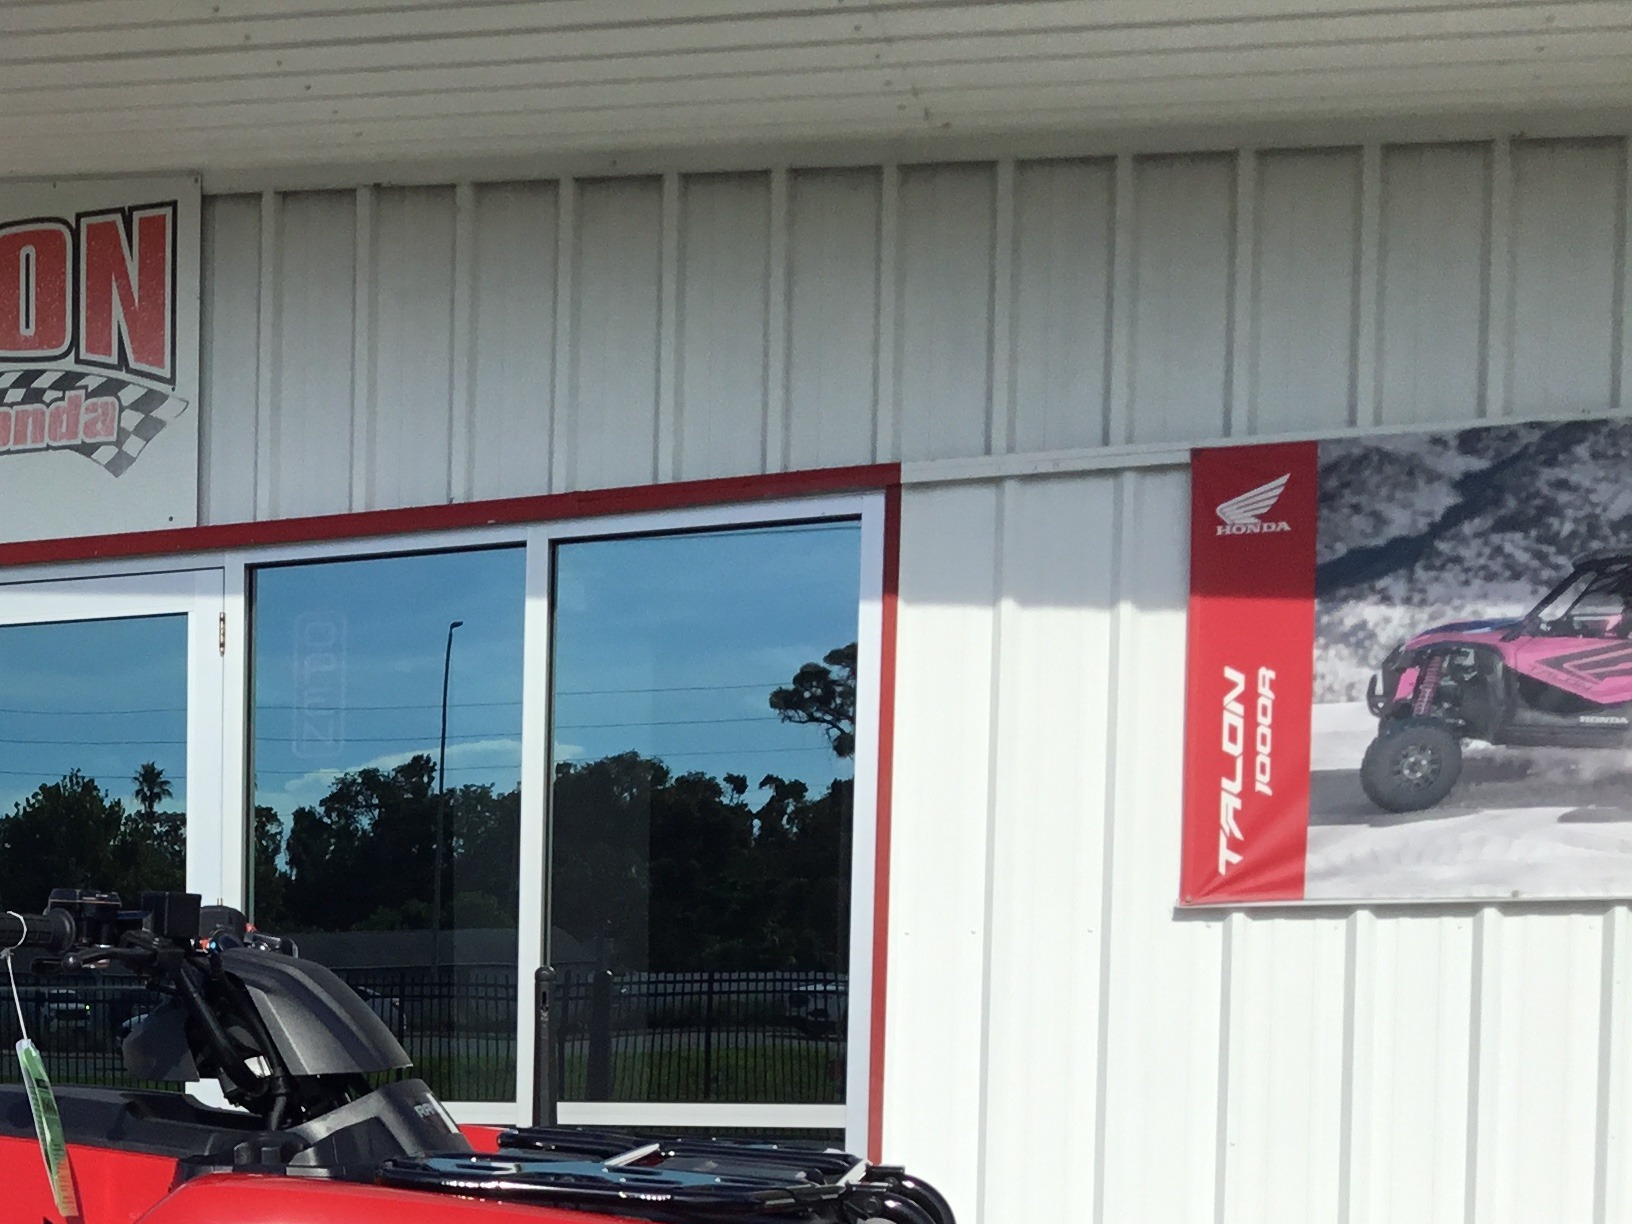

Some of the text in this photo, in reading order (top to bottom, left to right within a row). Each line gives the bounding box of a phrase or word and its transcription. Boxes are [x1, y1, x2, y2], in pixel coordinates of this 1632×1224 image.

[1216, 520, 1291, 536] HONDA
[1254, 666, 1277, 797] 1000R
[1579, 715, 1629, 724] HONDA
[1218, 666, 1247, 876] TALON
